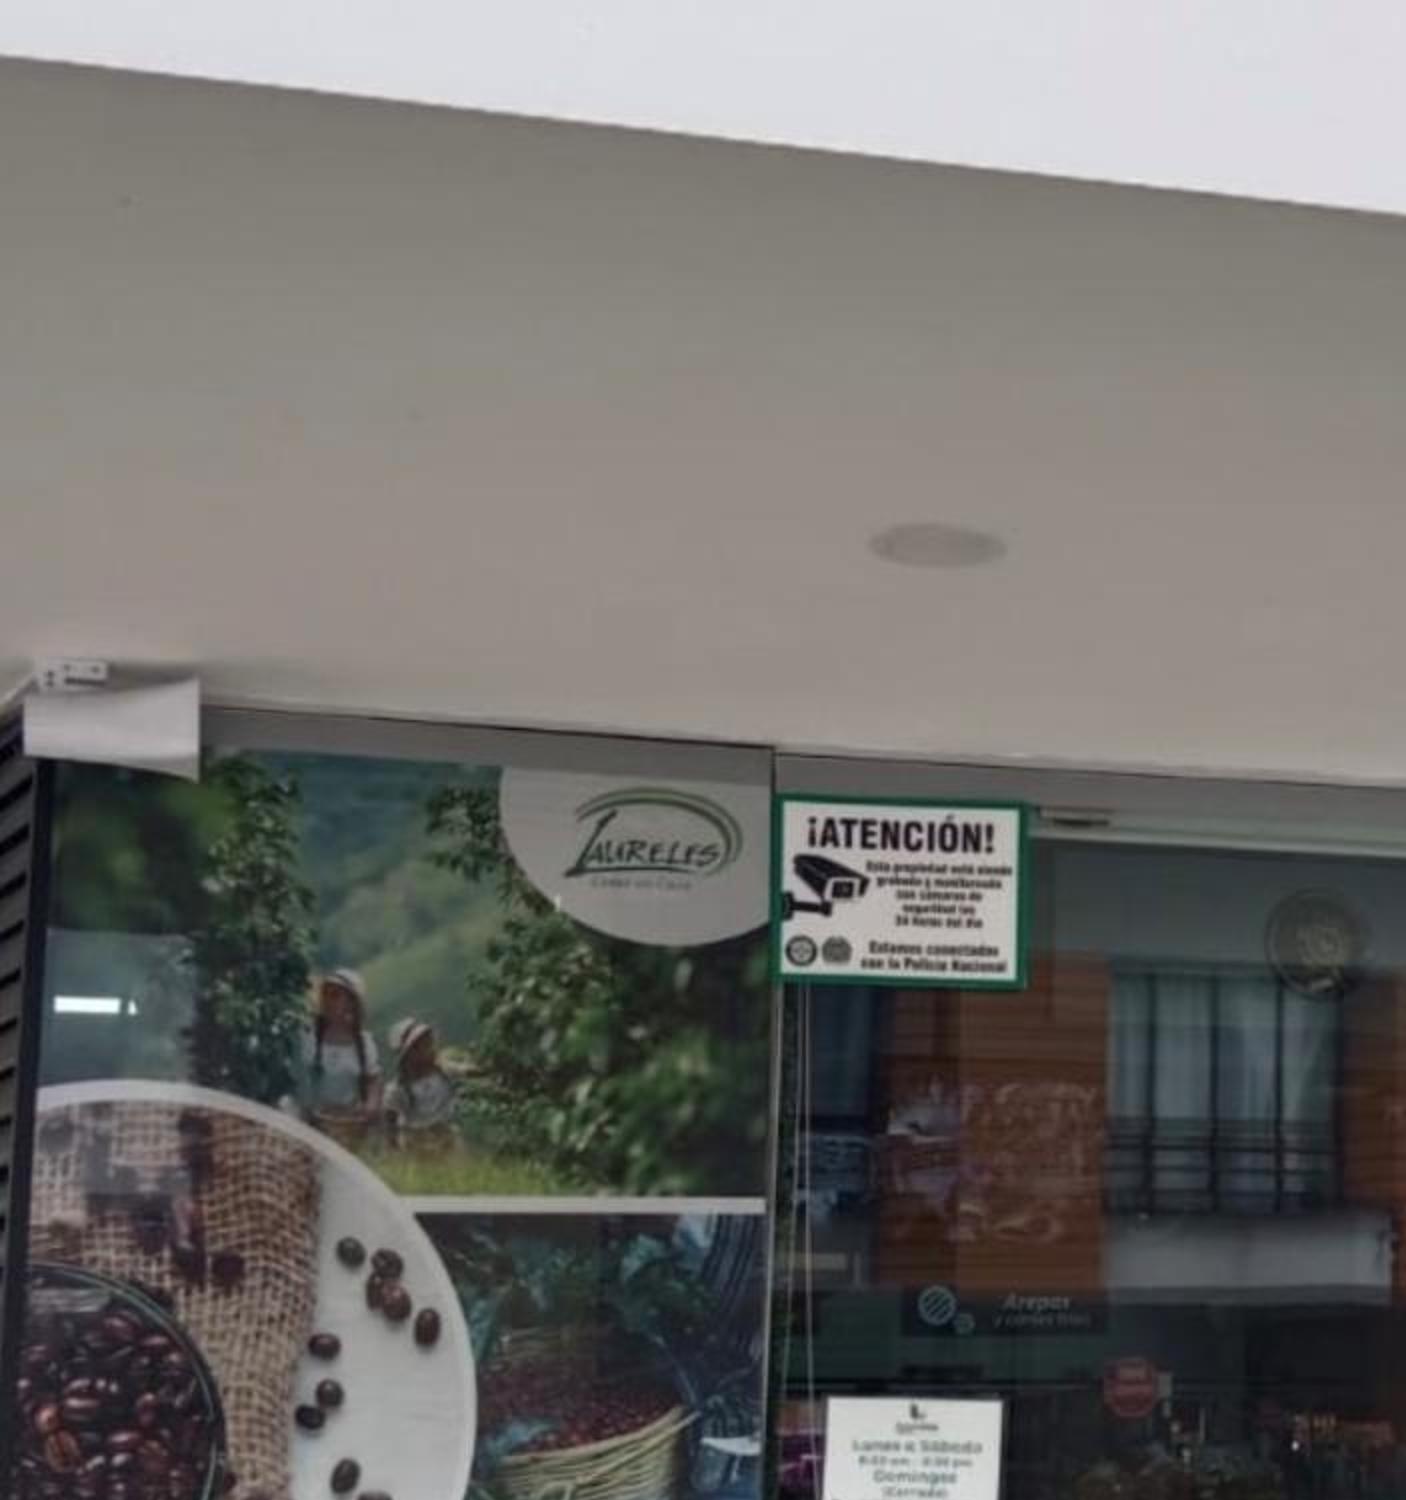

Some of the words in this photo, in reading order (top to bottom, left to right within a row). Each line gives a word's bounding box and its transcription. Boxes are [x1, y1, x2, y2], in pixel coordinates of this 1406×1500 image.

[565, 809, 719, 878] LAURELES
[807, 814, 995, 854] ¡ATENCIÓN!
[868, 940, 923, 955] Estamos
[952, 959, 1008, 974] Nacional
